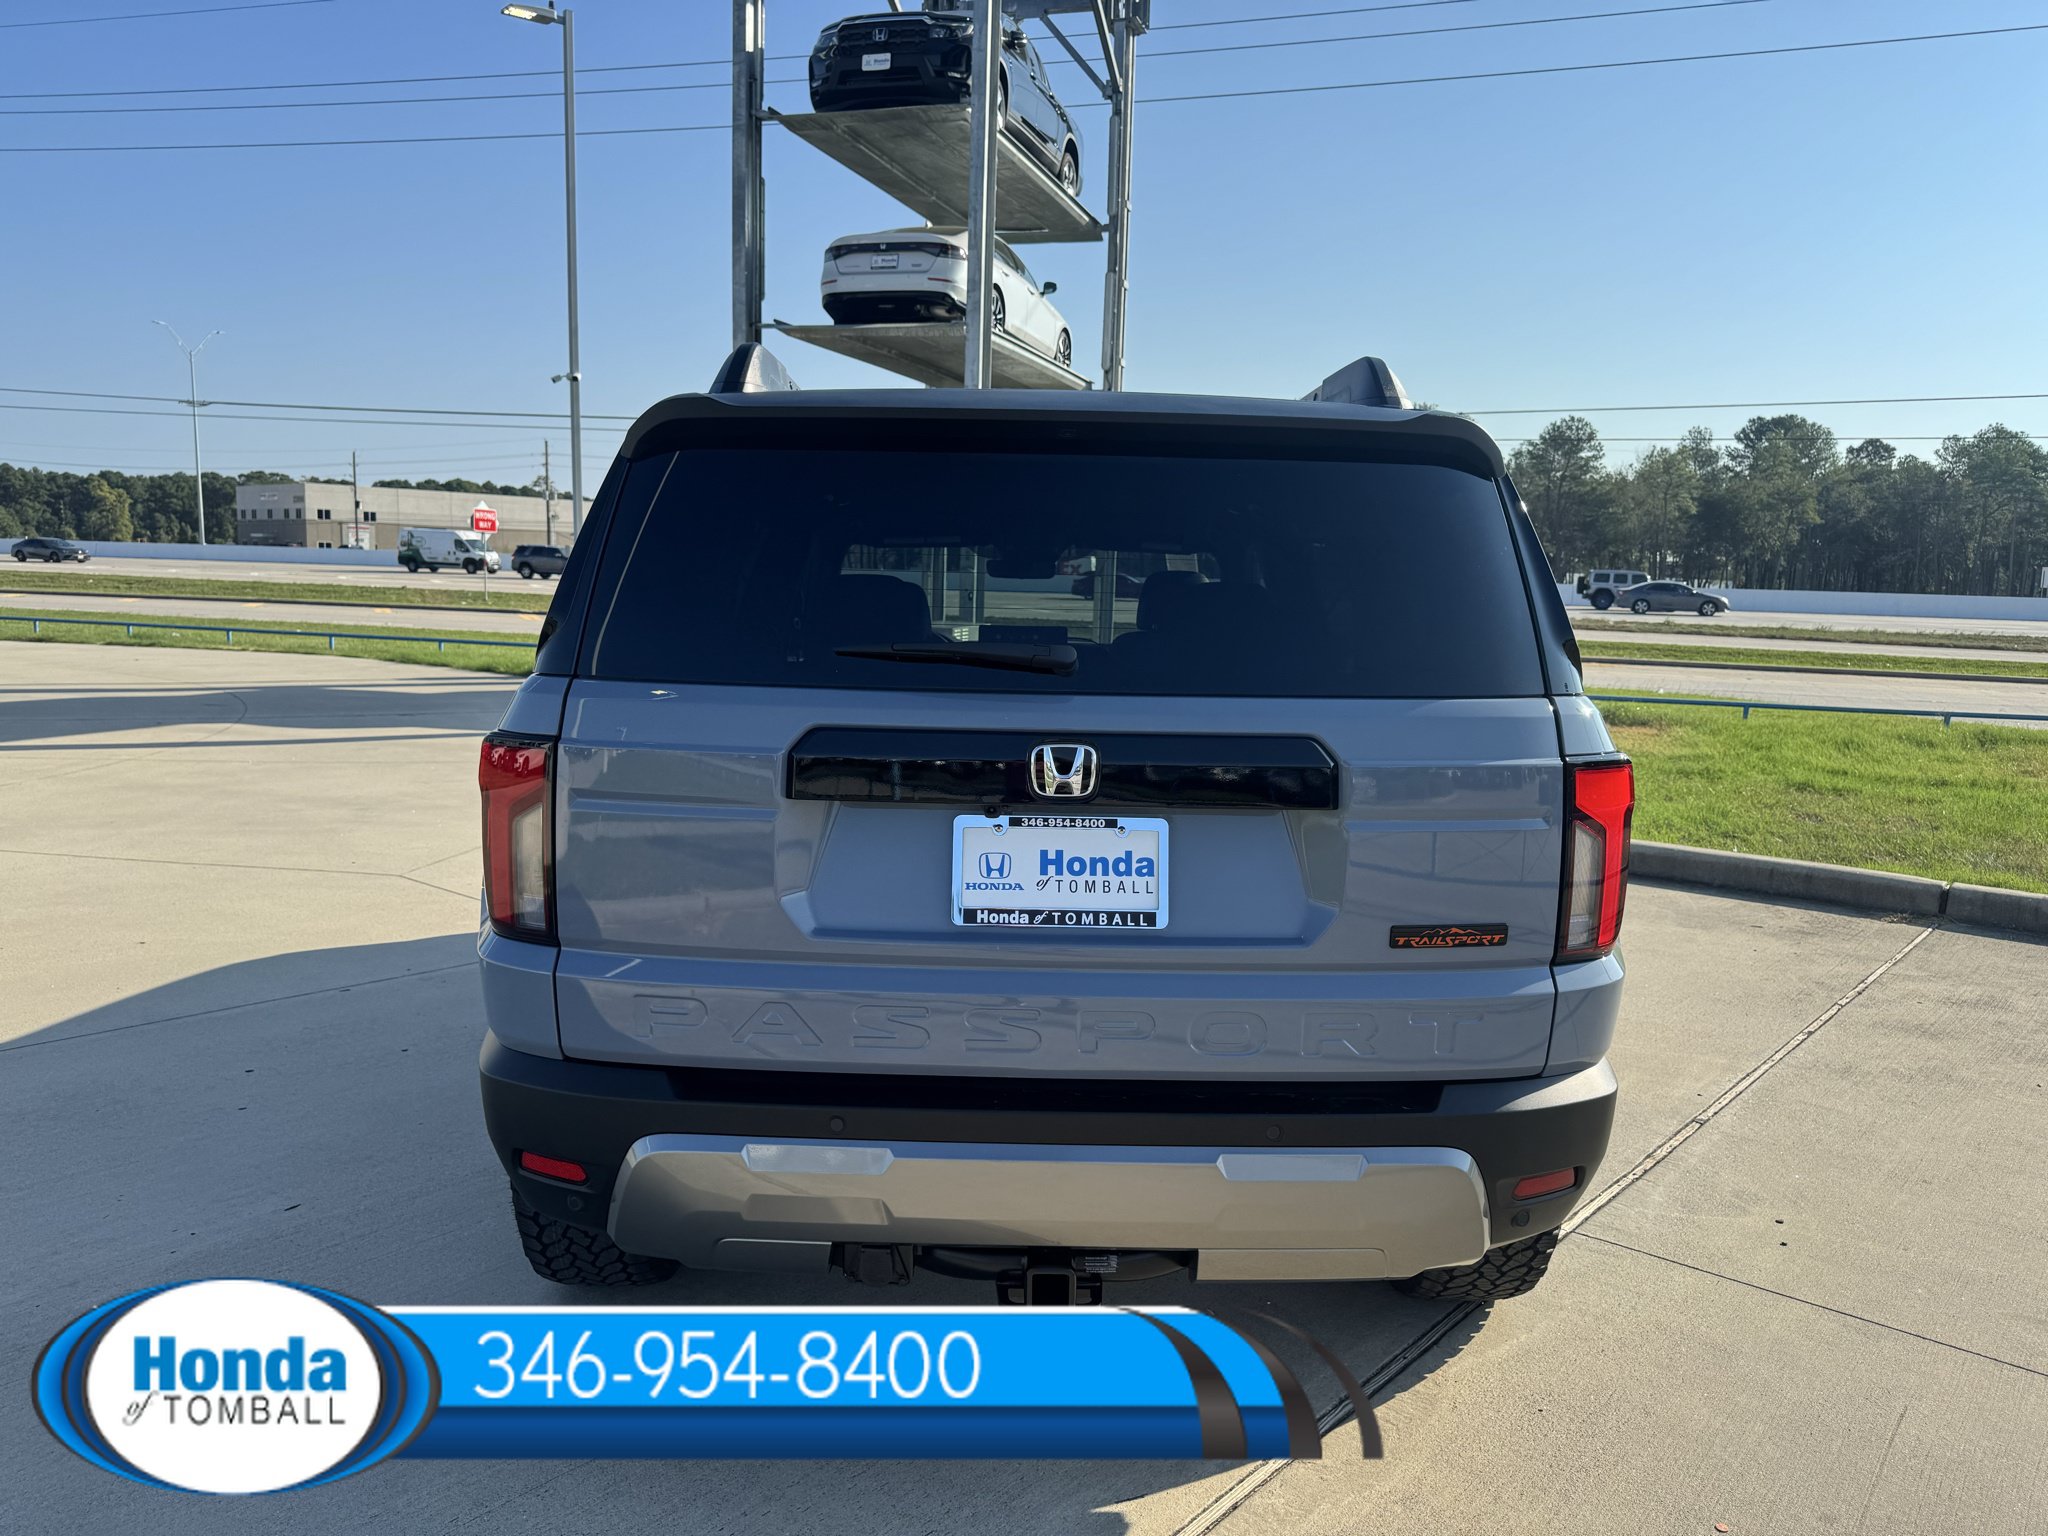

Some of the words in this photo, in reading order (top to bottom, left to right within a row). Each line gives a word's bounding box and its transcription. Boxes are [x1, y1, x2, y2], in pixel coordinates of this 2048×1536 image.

[478, 521, 492, 529] WAY
[1020, 817, 1106, 828] 346-954-8400
[1039, 849, 1155, 877] Honda
[964, 882, 1024, 891] HONDA
[1036, 876, 1053, 891] of
[1056, 879, 1154, 894] TOMBALL
[976, 910, 1029, 924] Honda
[1033, 911, 1048, 924] of
[1052, 912, 1148, 926] TOMBALL
[1395, 935, 1504, 947] TRAILSPORT
[633, 994, 1484, 1057] PASSPORT
